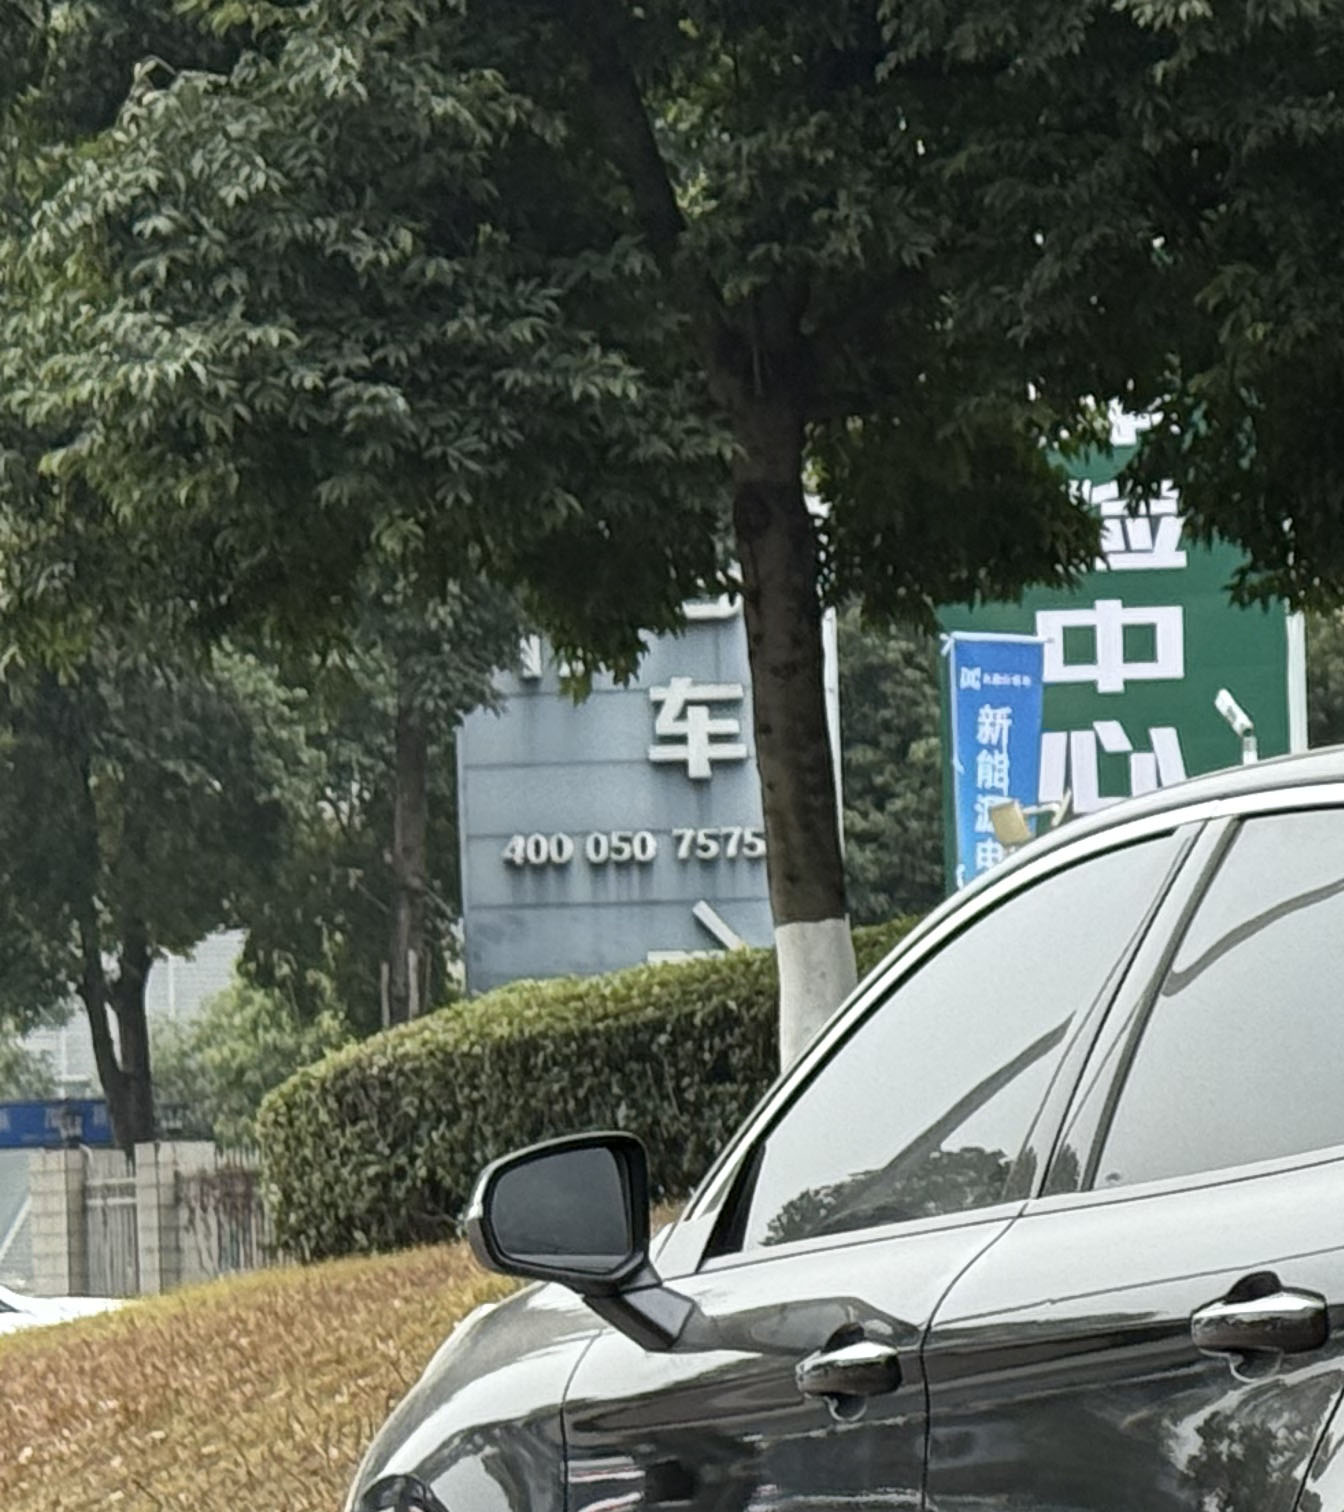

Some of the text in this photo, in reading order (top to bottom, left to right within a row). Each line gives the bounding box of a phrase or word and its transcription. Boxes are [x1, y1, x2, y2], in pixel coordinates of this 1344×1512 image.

[503, 826, 766, 866] 400 050 7575
